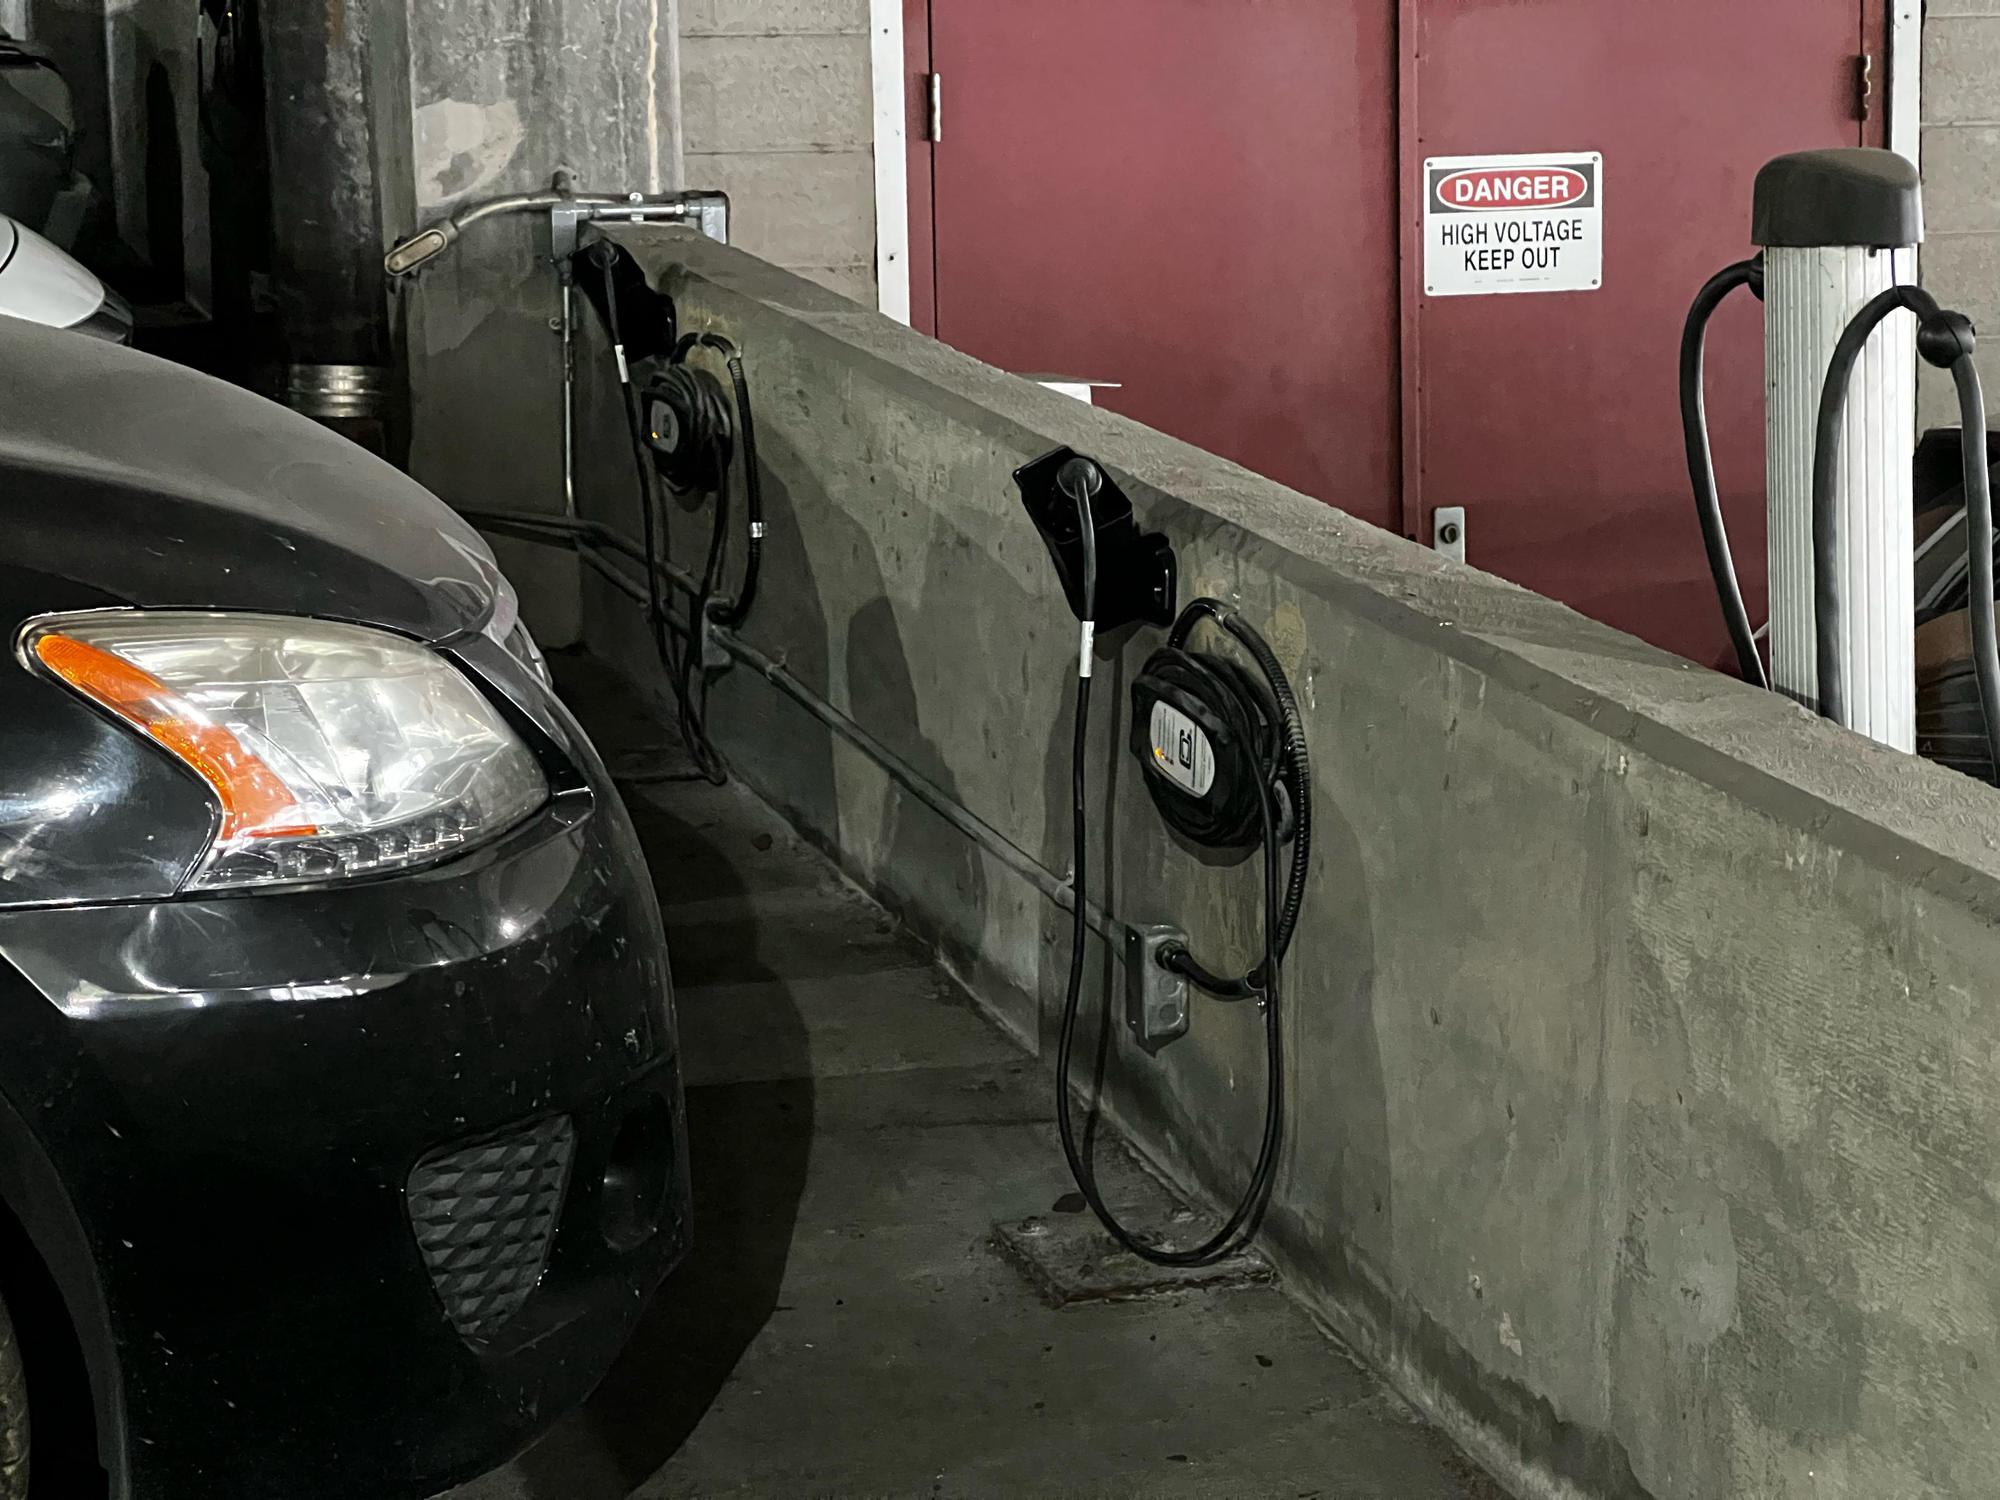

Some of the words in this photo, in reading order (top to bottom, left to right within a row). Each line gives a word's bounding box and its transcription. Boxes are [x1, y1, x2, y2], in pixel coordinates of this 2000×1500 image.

[1455, 175, 1569, 202] DANGER
[1442, 223, 1488, 245] HIGH
[1495, 219, 1583, 242] VOLTAGE
[1465, 249, 1515, 271] KEEP
[1521, 246, 1561, 269] OUT
